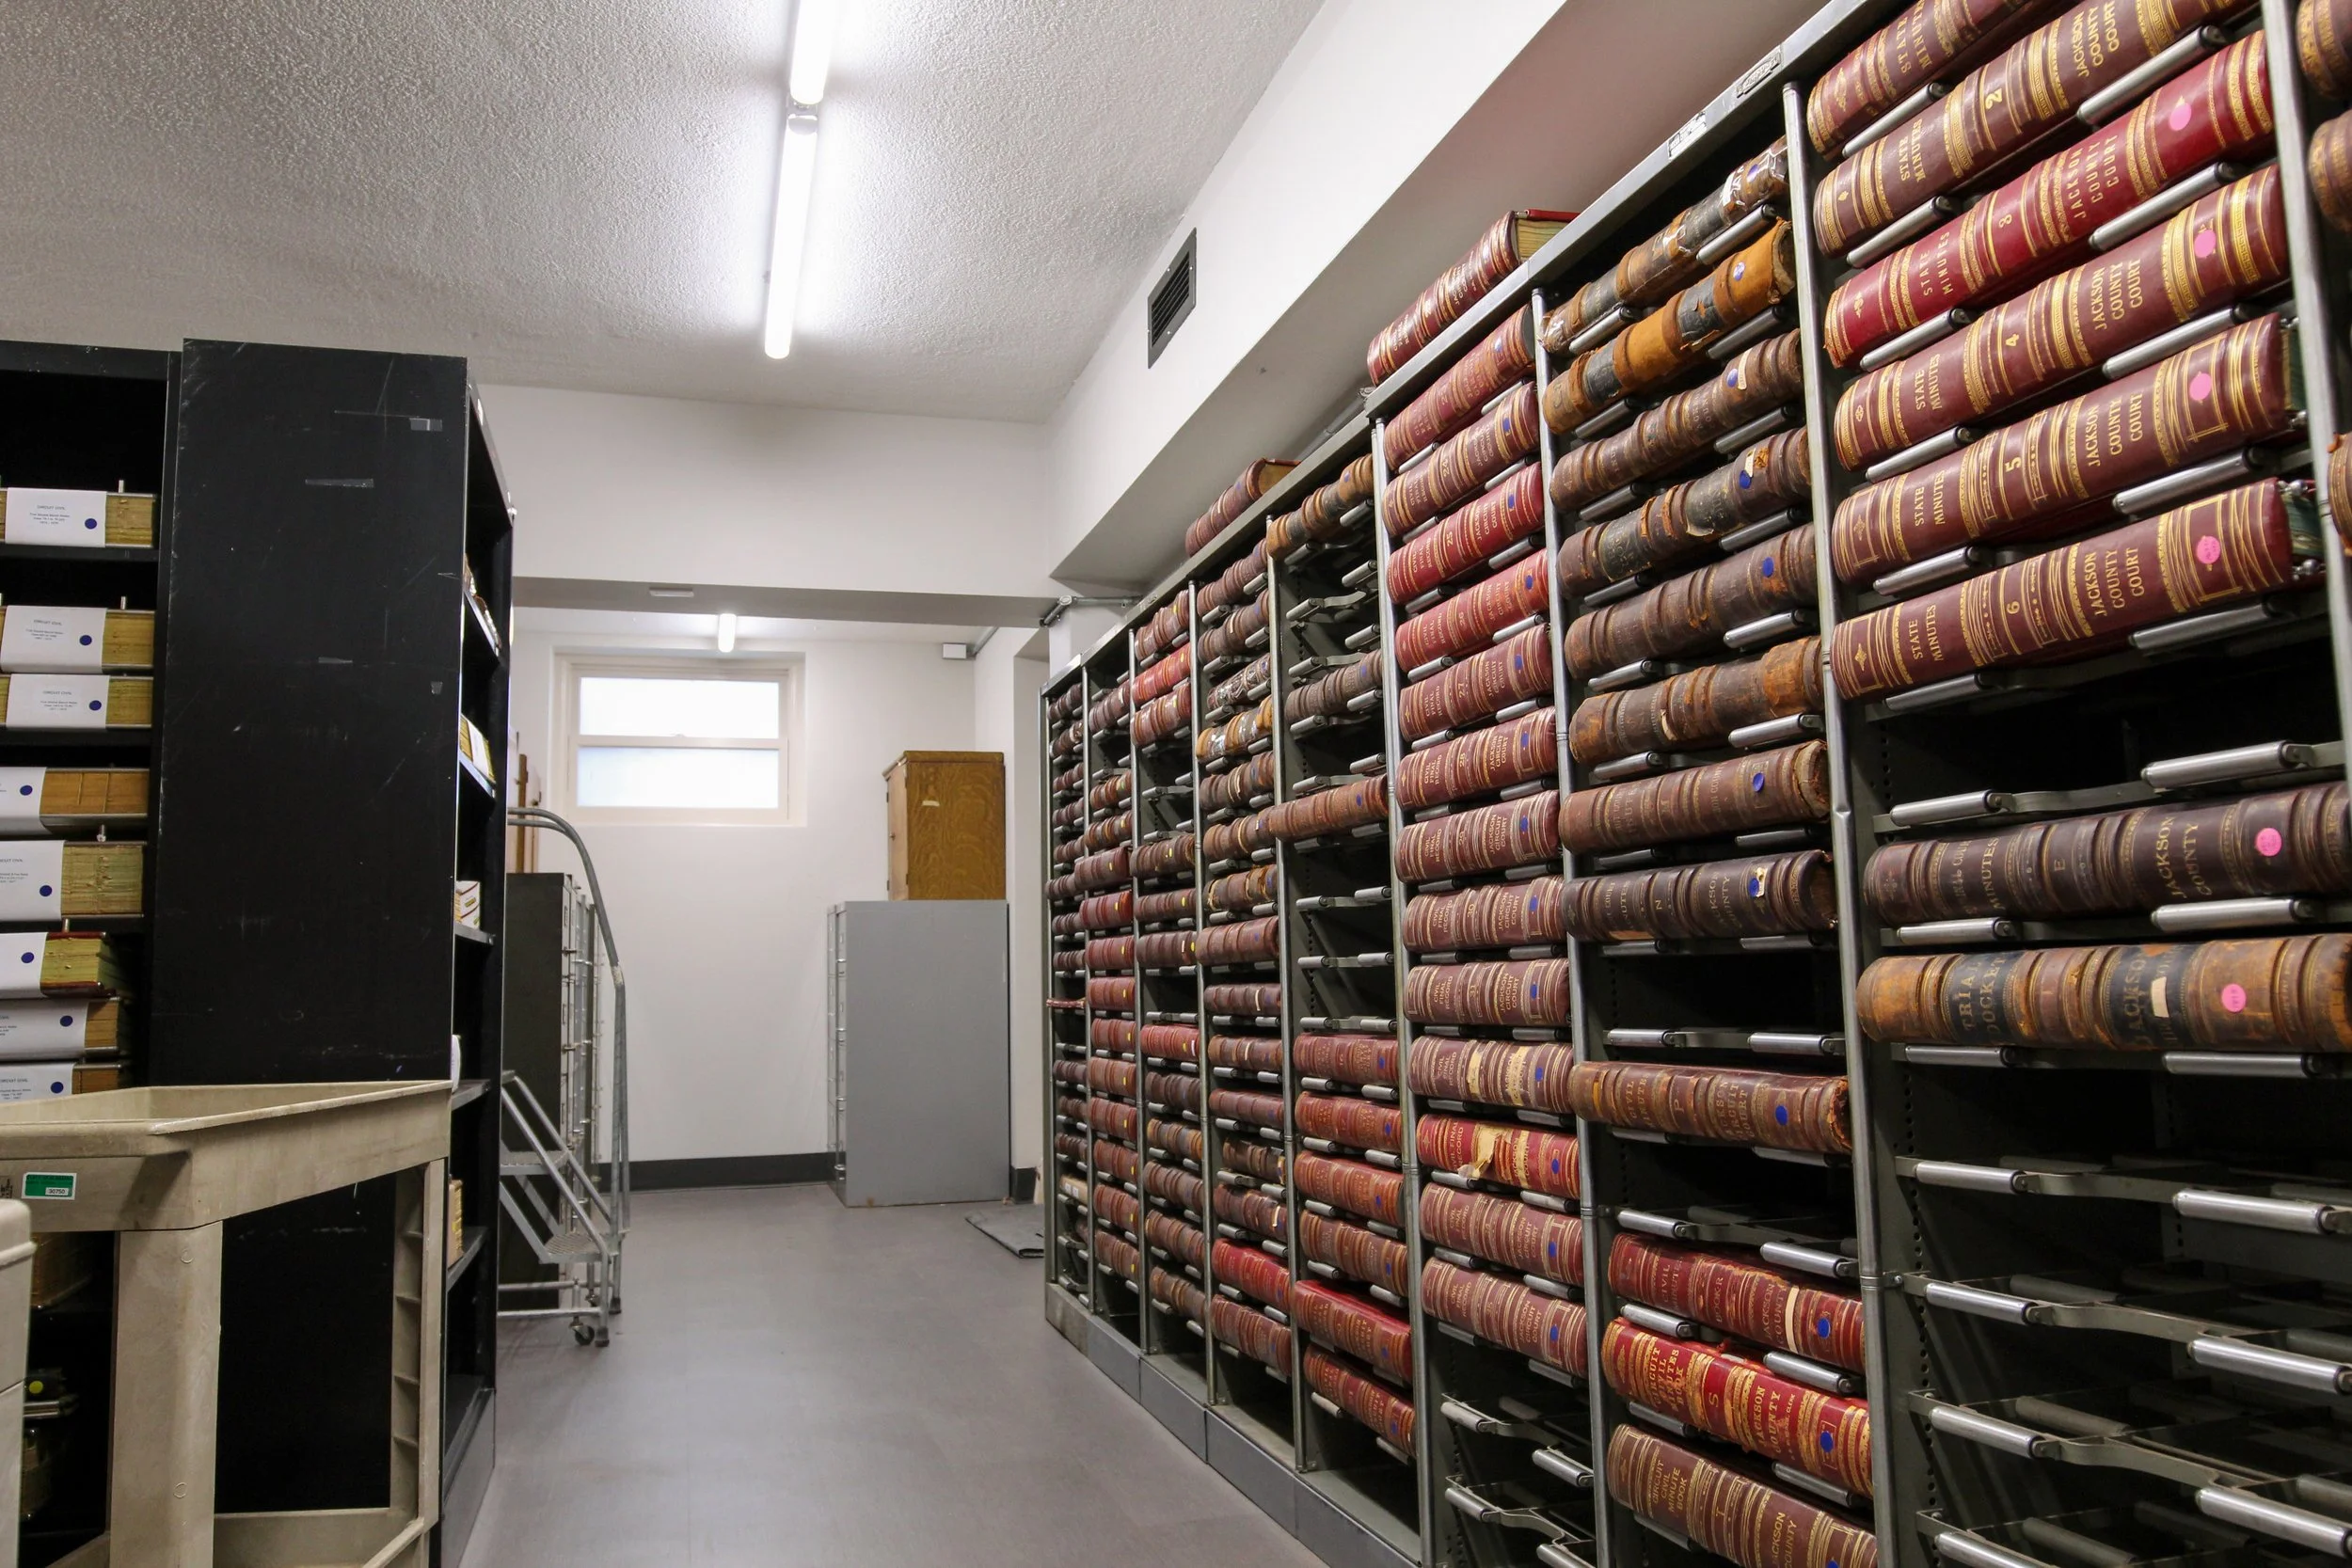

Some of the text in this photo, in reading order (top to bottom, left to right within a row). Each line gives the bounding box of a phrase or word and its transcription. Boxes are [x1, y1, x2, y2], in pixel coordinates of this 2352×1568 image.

[1897, 16, 1912, 74] STATE
[2070, 11, 2090, 77] JACKSON
[2087, 6, 2105, 67] COUNTY
[1985, 87, 2003, 110] 2
[1899, 135, 1911, 182] STATE
[1911, 118, 1927, 182] MINUTES
[2103, 135, 2121, 188] COURT
[2066, 147, 2088, 219] JACKSON
[2085, 141, 2105, 204] COUNTY
[1918, 249, 1933, 297] STATE
[1935, 231, 1954, 295] MINUTES
[2090, 266, 2108, 331] JACKSON
[2108, 261, 2125, 321] COUNTY
[2127, 258, 2143, 309] COURT
[2005, 333, 2021, 348] 4
[1914, 368, 1927, 411] STATE
[1929, 353, 1943, 411] MINUTES
[2084, 404, 2101, 468] JACKSON
[2107, 395, 2123, 456] COUNTY
[2128, 390, 2144, 443] COURT
[1441, 457, 1451, 478] 24
[2004, 455, 2023, 473] 5
[1490, 499, 1499, 530] COURT
[1914, 485, 1926, 527] STATE
[1932, 469, 1947, 526] MINUTES
[1473, 504, 1484, 542] JACKSON
[1482, 502, 1491, 536] CIRCUIT
[1446, 531, 1454, 548] 25
[2083, 550, 2107, 617] JACKSON
[2104, 548, 2126, 610] COUNTY
[2124, 546, 2145, 597] COURT
[1457, 610, 1467, 627] 26
[2006, 601, 2021, 615] 6
[1908, 619, 1924, 660] STATE
[1925, 603, 1945, 662] MINUTES
[1456, 682, 1467, 699] 27
[1484, 659, 1495, 698] JACKSON
[1488, 735, 1499, 772] JACKSON
[1501, 736, 1510, 765] COURT
[1429, 758, 1438, 784] FINAL
[1488, 813, 1498, 855] JACKSON
[1494, 815, 1503, 852] CIRCUIT
[1500, 816, 1508, 848] COURT
[1981, 837, 2007, 911] MINUTES
[2155, 816, 2187, 899] JACKSON
[2183, 823, 2214, 895] COUNTY
[1467, 903, 1476, 919] 30
[1498, 891, 1509, 930] JACKSON
[1504, 894, 1515, 929] CIRCUIT
[1511, 895, 1520, 926] COURT
[1655, 899, 1663, 911] N
[1433, 982, 1441, 1004] CIVIL
[1438, 980, 1447, 1006] FINAL
[1444, 975, 1454, 1010] RECORD
[1469, 985, 1478, 999] 31
[1499, 972, 1509, 1013] JACKSON
[1505, 974, 1515, 1011] CIRCUIT
[1511, 977, 1520, 1009] COURT
[1625, 1080, 1638, 1119] CIVIL
[1673, 1098, 1685, 1114] P
[1738, 1089, 1756, 1138] COURT
[1517, 1216, 1528, 1259] JACKSON
[1523, 1221, 1534, 1259] CIRCUIT
[1531, 1225, 1540, 1259] COURT
[1518, 1299, 1532, 1341] JACKSON
[1525, 1305, 1536, 1343] CIRCUIT
[1533, 1309, 1543, 1344] COURT
[1674, 1367, 1685, 1406] BOOK
[1708, 1392, 1720, 1408] S
[1753, 1386, 1767, 1447] JACKSON
[1768, 1390, 1782, 1453] COUNTY
[1652, 1459, 1665, 1505] CIRCUIT
[1660, 1473, 1671, 1499] CIVIL
[1668, 1467, 1682, 1513] MINUTE
[1677, 1477, 1689, 1511] BOOK
